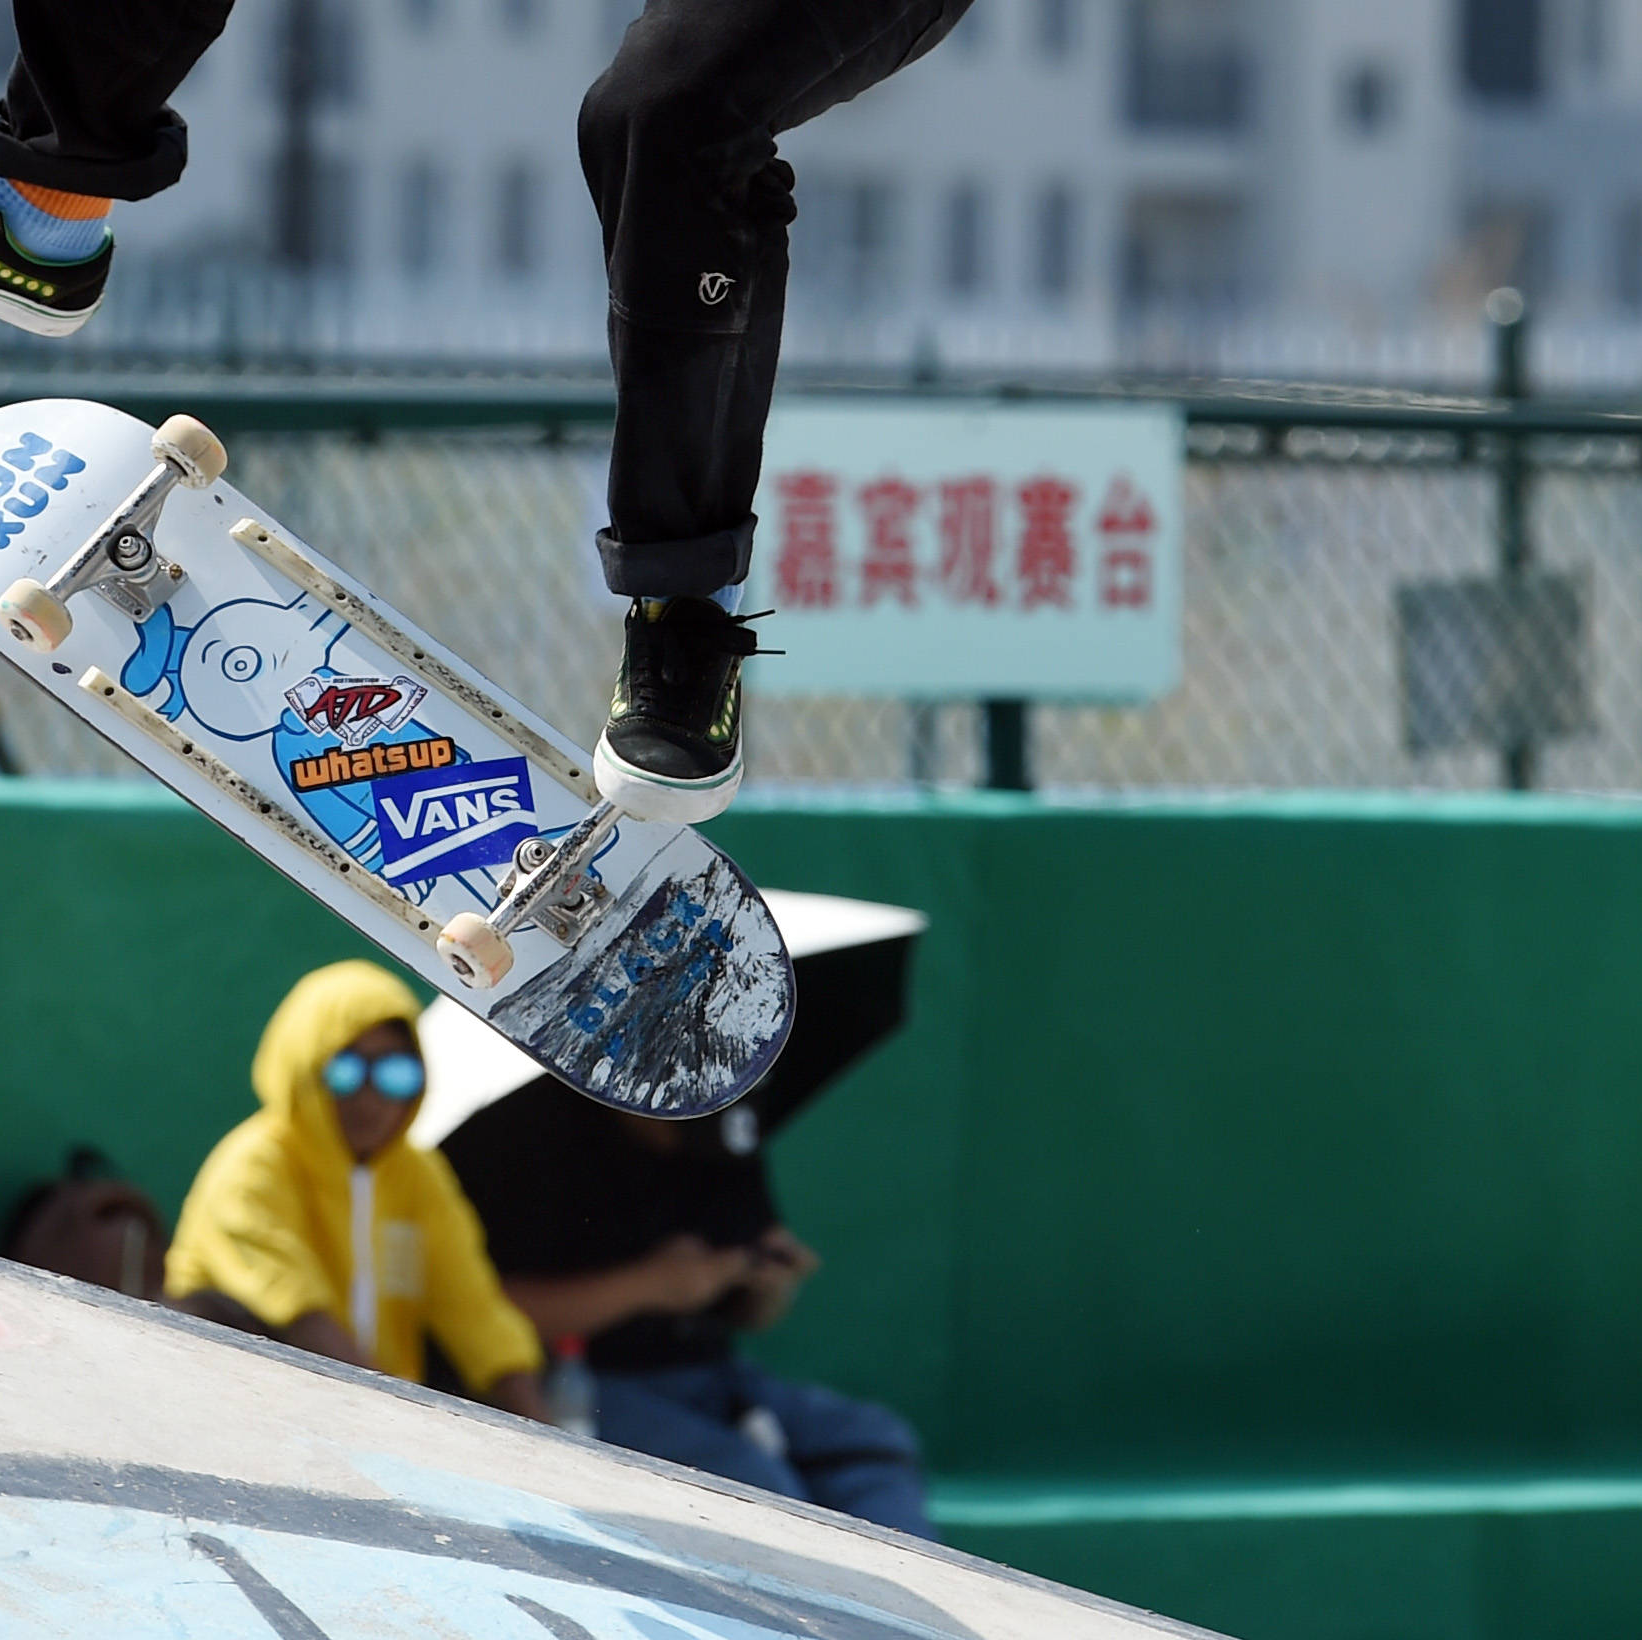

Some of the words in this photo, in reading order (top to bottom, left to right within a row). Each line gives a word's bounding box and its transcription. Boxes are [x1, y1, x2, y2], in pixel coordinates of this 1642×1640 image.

[774, 468, 1155, 611] 嘉宾观赛台
[379, 775, 522, 840] VANS
